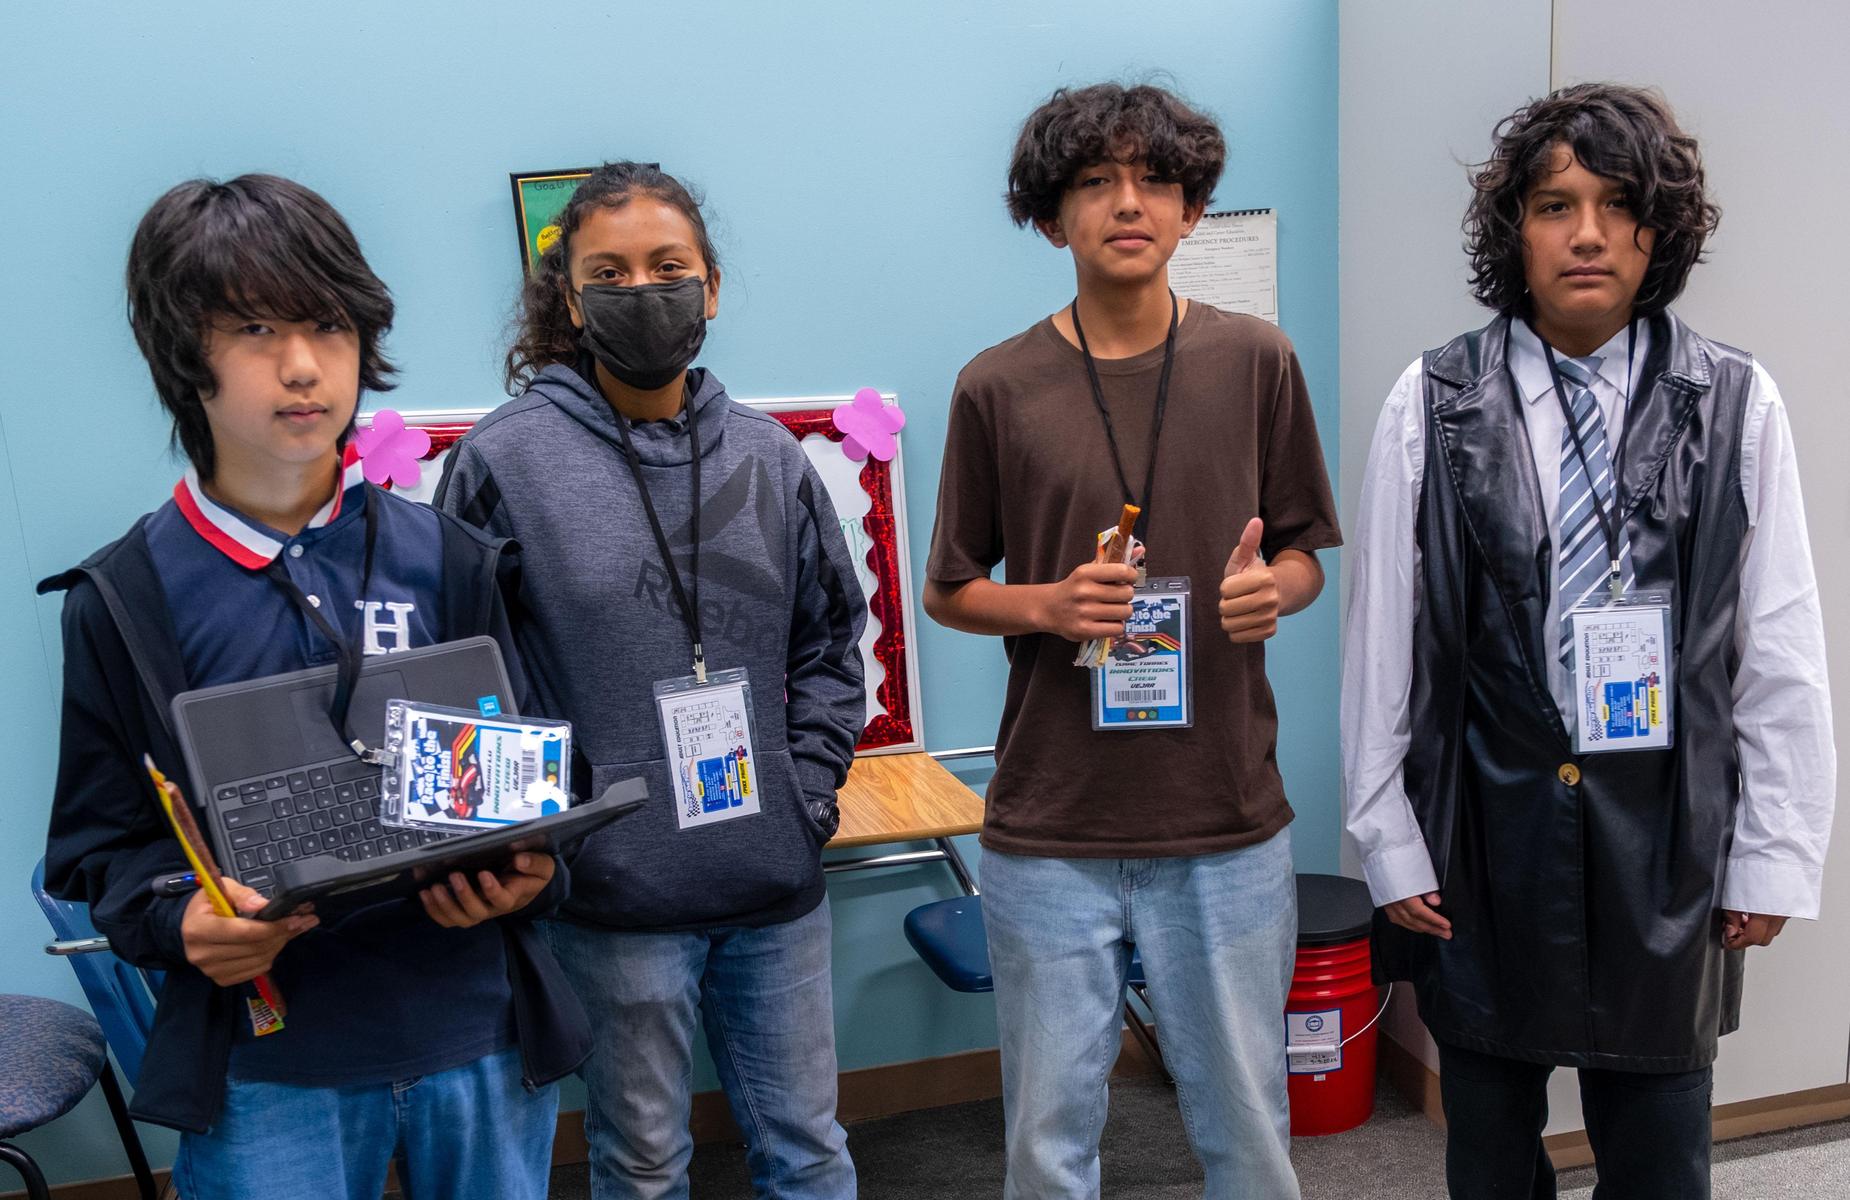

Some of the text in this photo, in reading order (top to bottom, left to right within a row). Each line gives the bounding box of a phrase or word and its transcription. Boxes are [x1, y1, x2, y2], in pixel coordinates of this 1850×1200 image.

[1219, 236, 1259, 244] PROCEDURES
[354, 600, 415, 656] H
[1125, 621, 1157, 633] Finish
[1138, 610, 1150, 620] to
[1152, 609, 1171, 619] the
[420, 730, 438, 804] Race to the
[437, 750, 452, 788] Finish
[493, 735, 503, 814] INNOVATIONS
